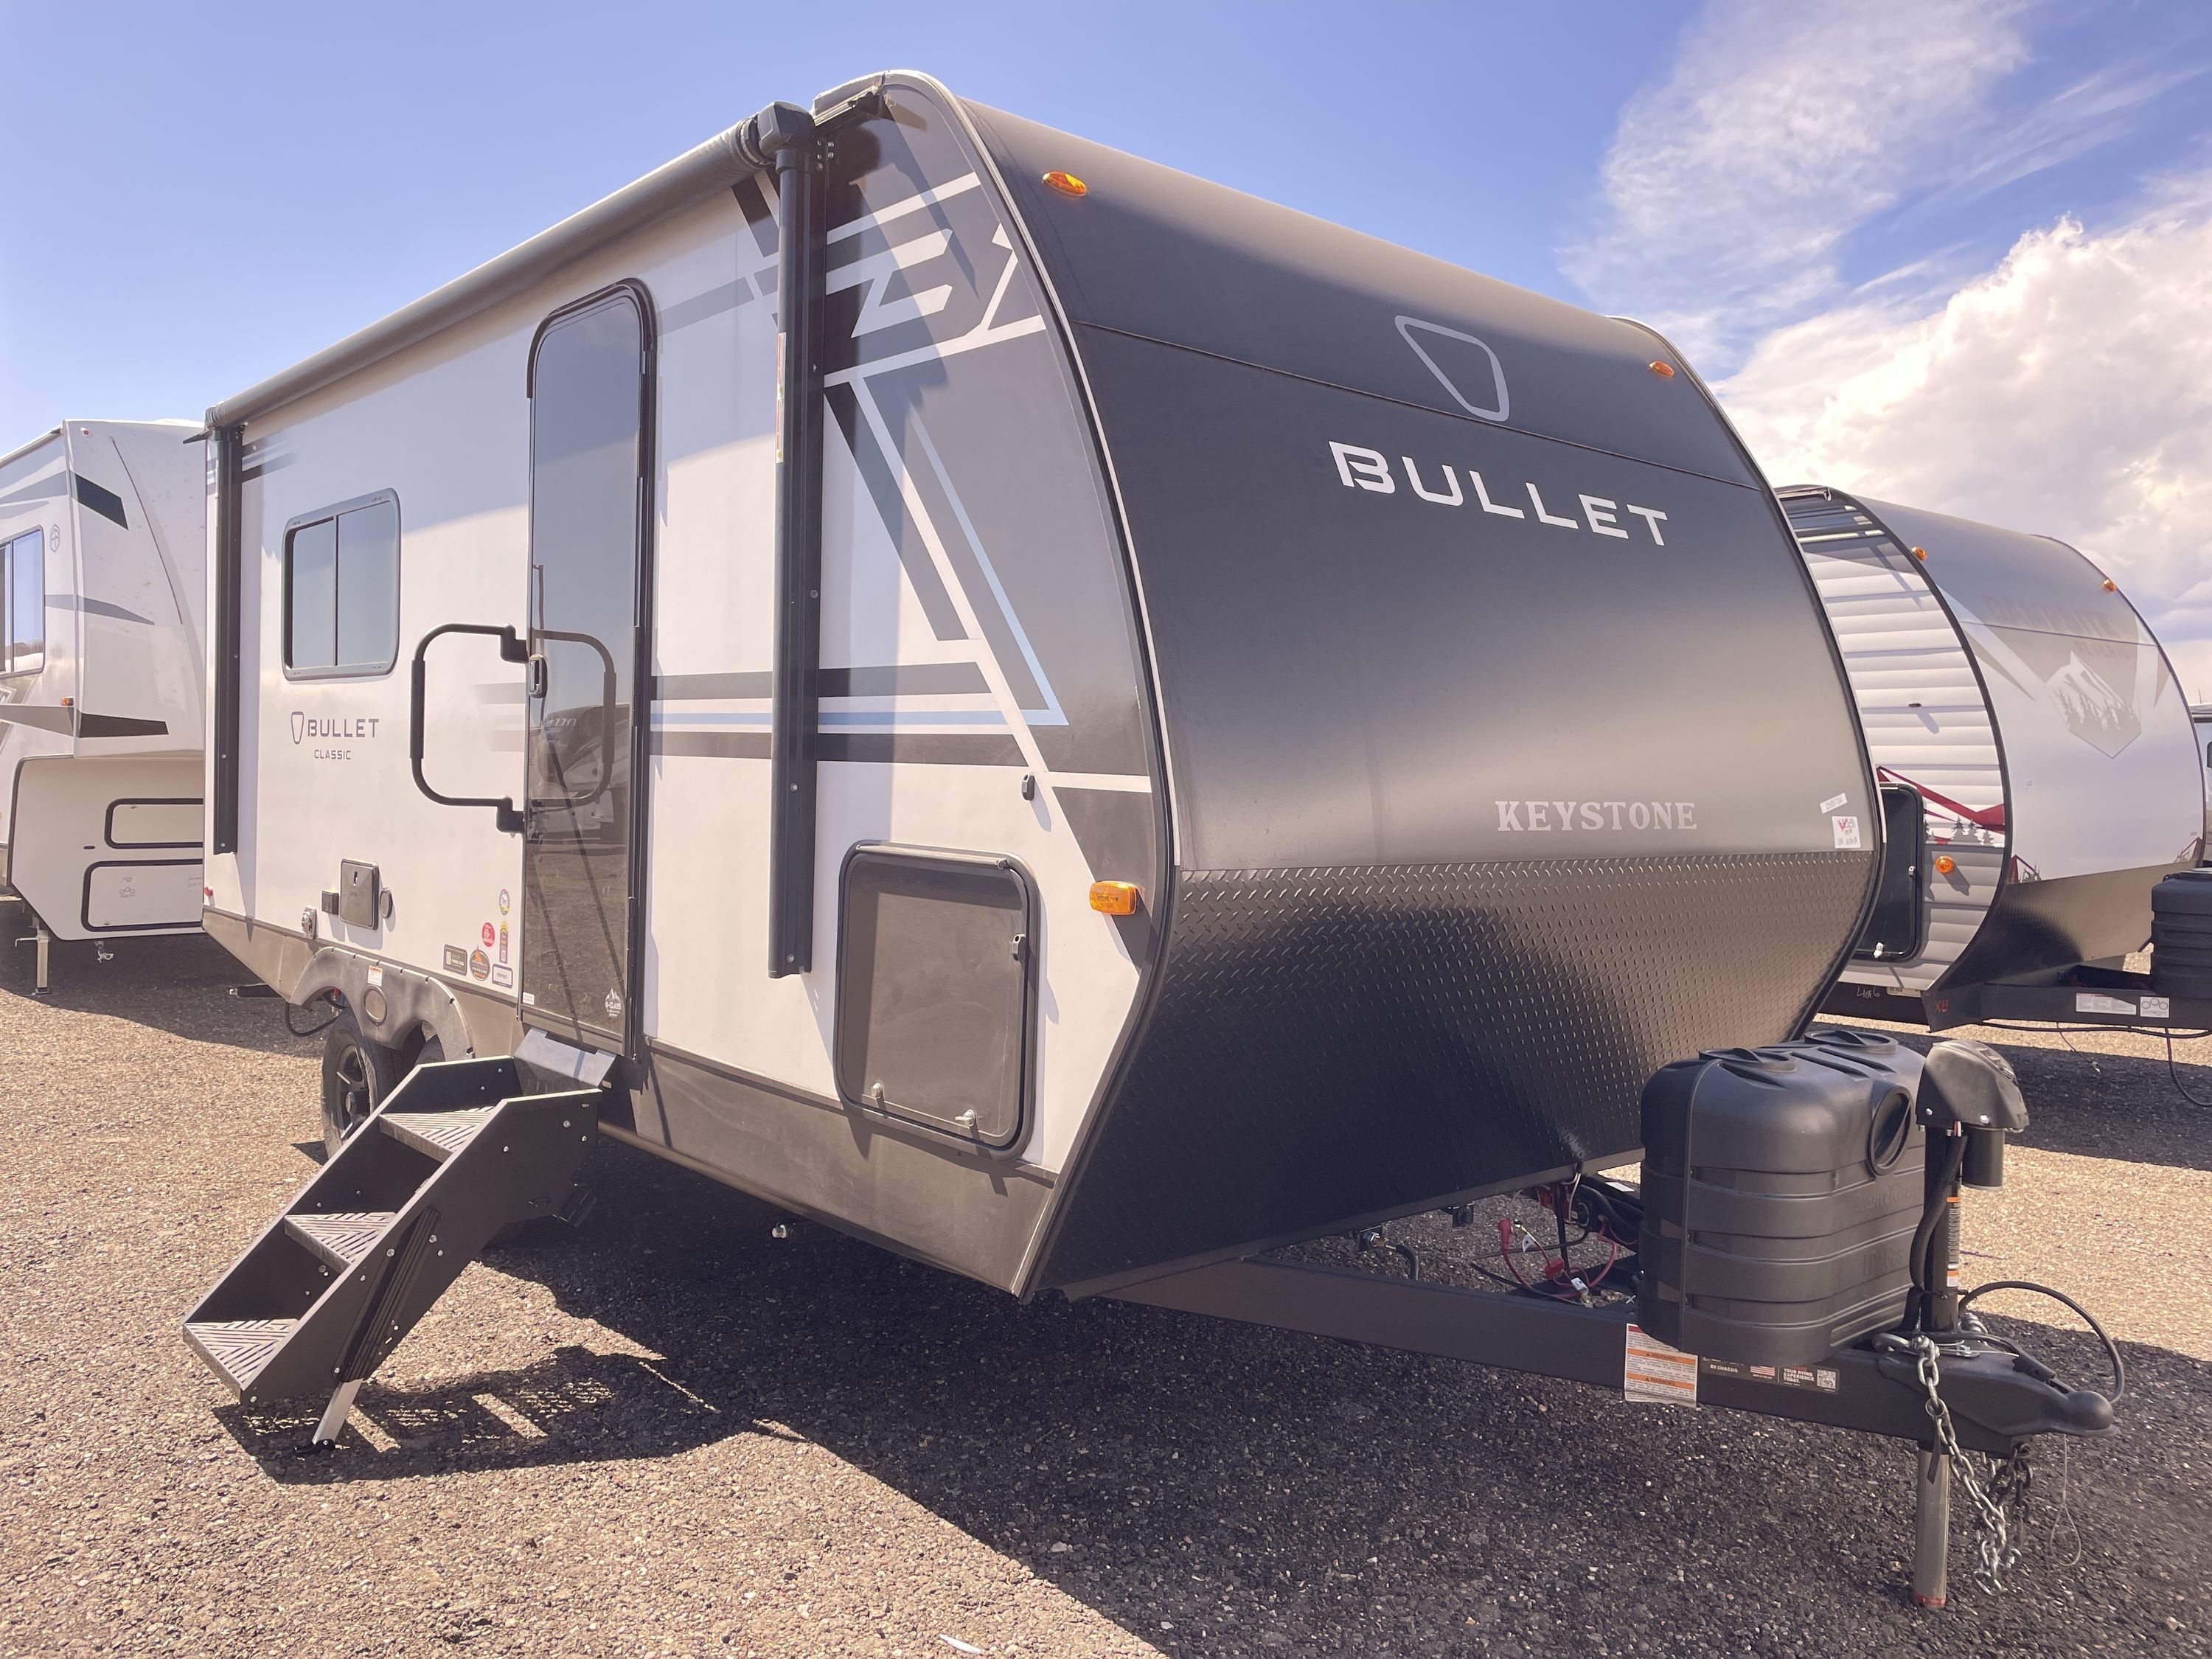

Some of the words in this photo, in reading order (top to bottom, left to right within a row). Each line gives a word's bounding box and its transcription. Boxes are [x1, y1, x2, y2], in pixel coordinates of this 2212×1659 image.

[1329, 440, 1668, 546] BULLET
[307, 718, 379, 738] BULLET
[314, 749, 351, 760] CLASSIC
[1495, 801, 1698, 832] KEYSTONE
[1651, 1352, 1677, 1361] WARNING
[1717, 1365, 1738, 1373] CHASSIS
[1650, 1377, 1676, 1386] WARNING
[1783, 1373, 1815, 1382] EXPERIENCE
